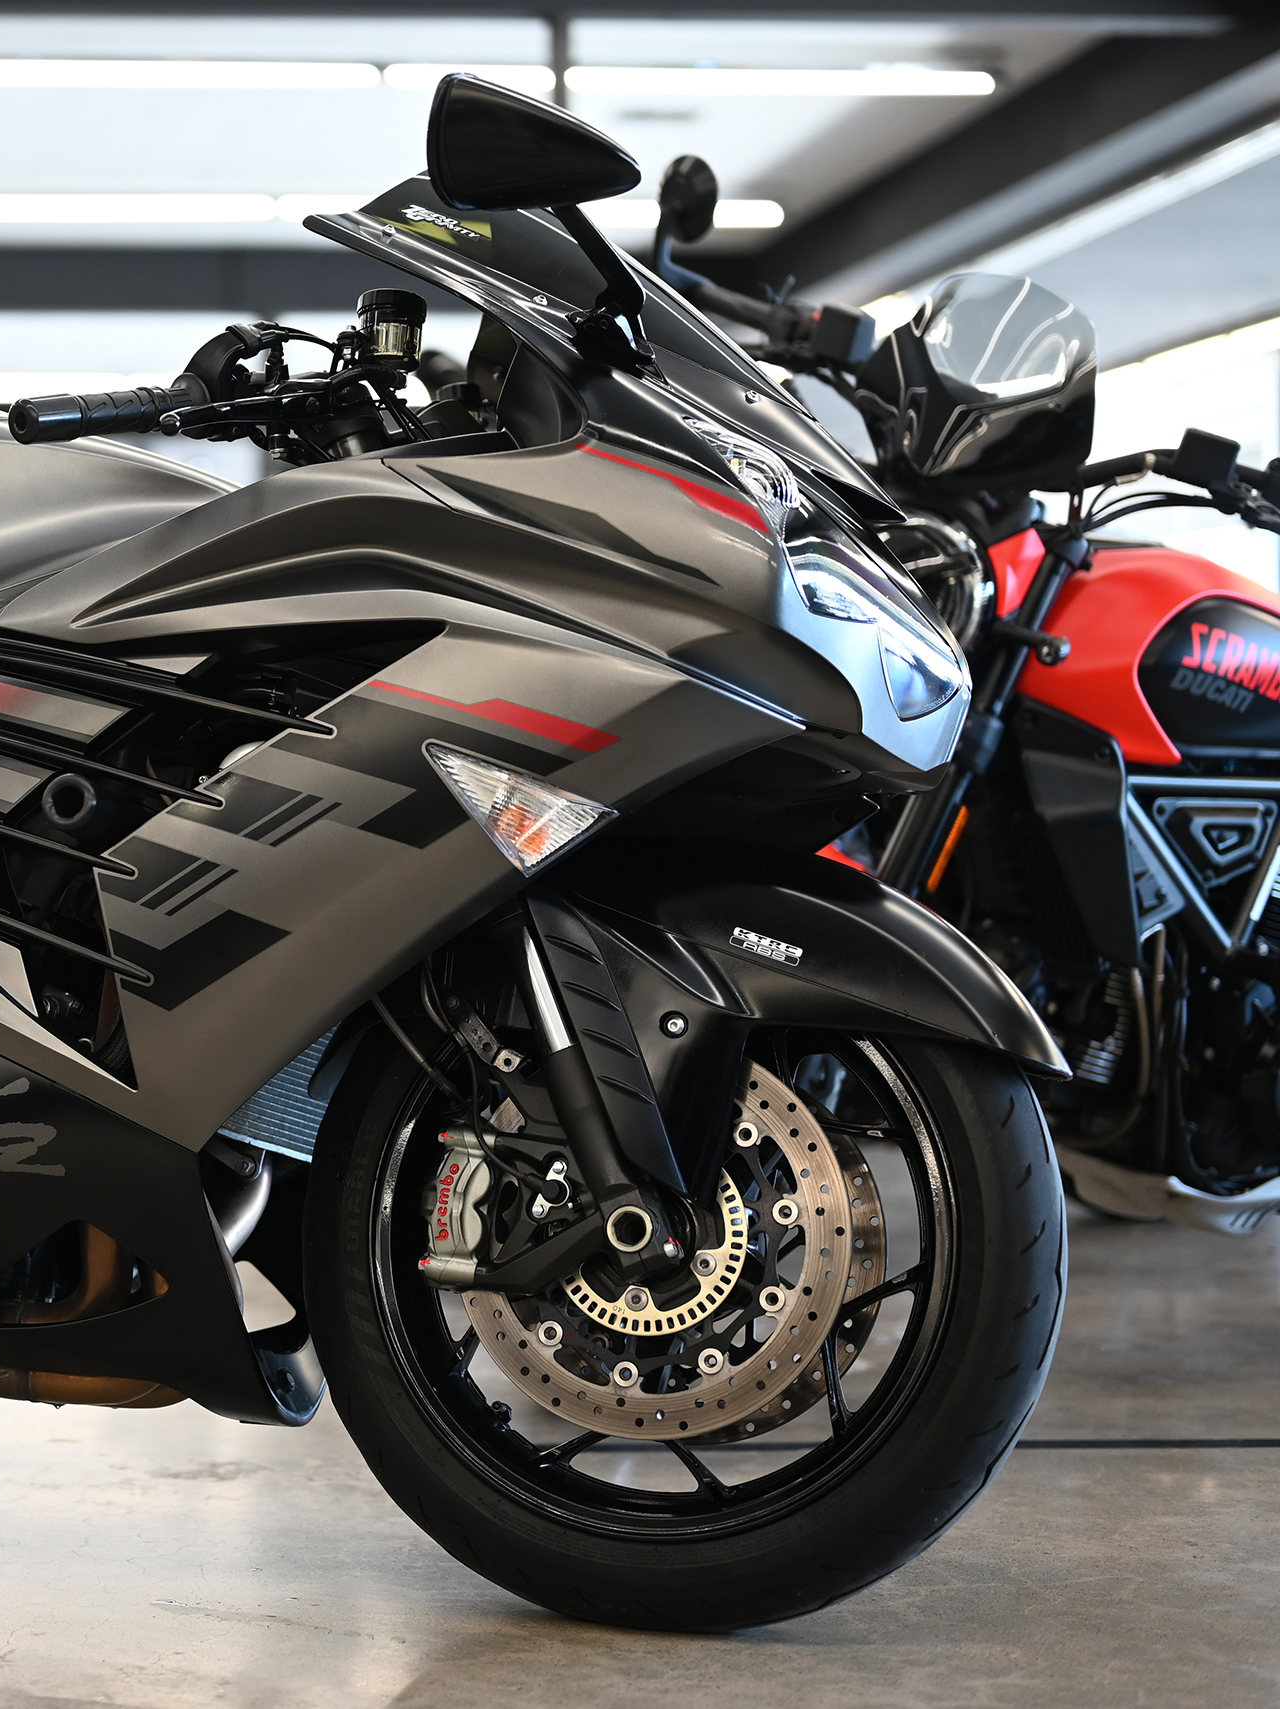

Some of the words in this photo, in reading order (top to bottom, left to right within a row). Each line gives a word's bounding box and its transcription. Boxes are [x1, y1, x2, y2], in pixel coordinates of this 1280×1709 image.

[400, 204, 459, 225] ZERO
[405, 212, 481, 238] GRAVITY
[1169, 666, 1255, 714] DUCATI
[742, 940, 787, 962] ABS
[341, 1119, 383, 1254] DIABLO
[435, 1163, 460, 1241] brembo
